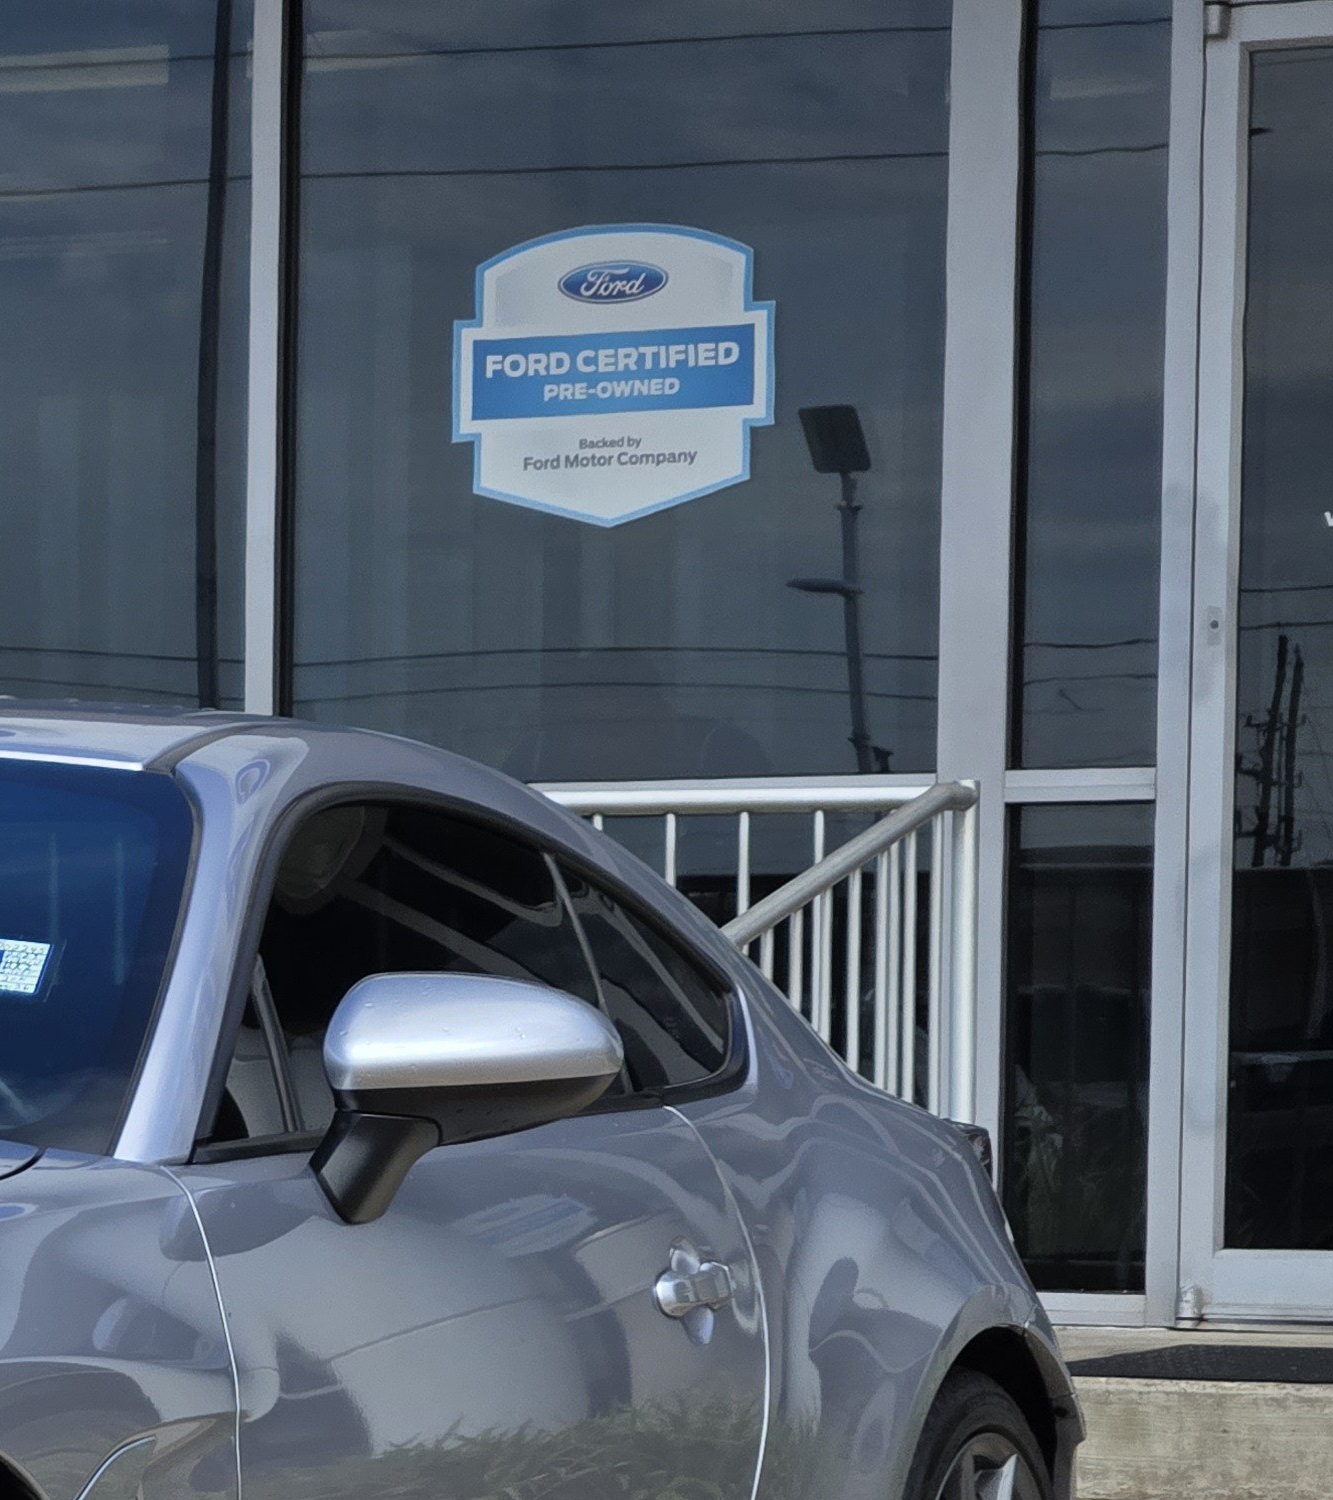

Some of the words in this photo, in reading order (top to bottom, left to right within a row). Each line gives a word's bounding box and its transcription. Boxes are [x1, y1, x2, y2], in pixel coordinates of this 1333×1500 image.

[579, 267, 646, 297] Ford
[485, 351, 571, 378] FORD
[576, 341, 740, 373] CERTIFIED
[543, 377, 681, 402] PRE-OWNED
[579, 437, 624, 450] Backed
[627, 436, 642, 449] by
[523, 455, 560, 471] Ford
[564, 453, 613, 469] Motor
[617, 449, 698, 467] Company
